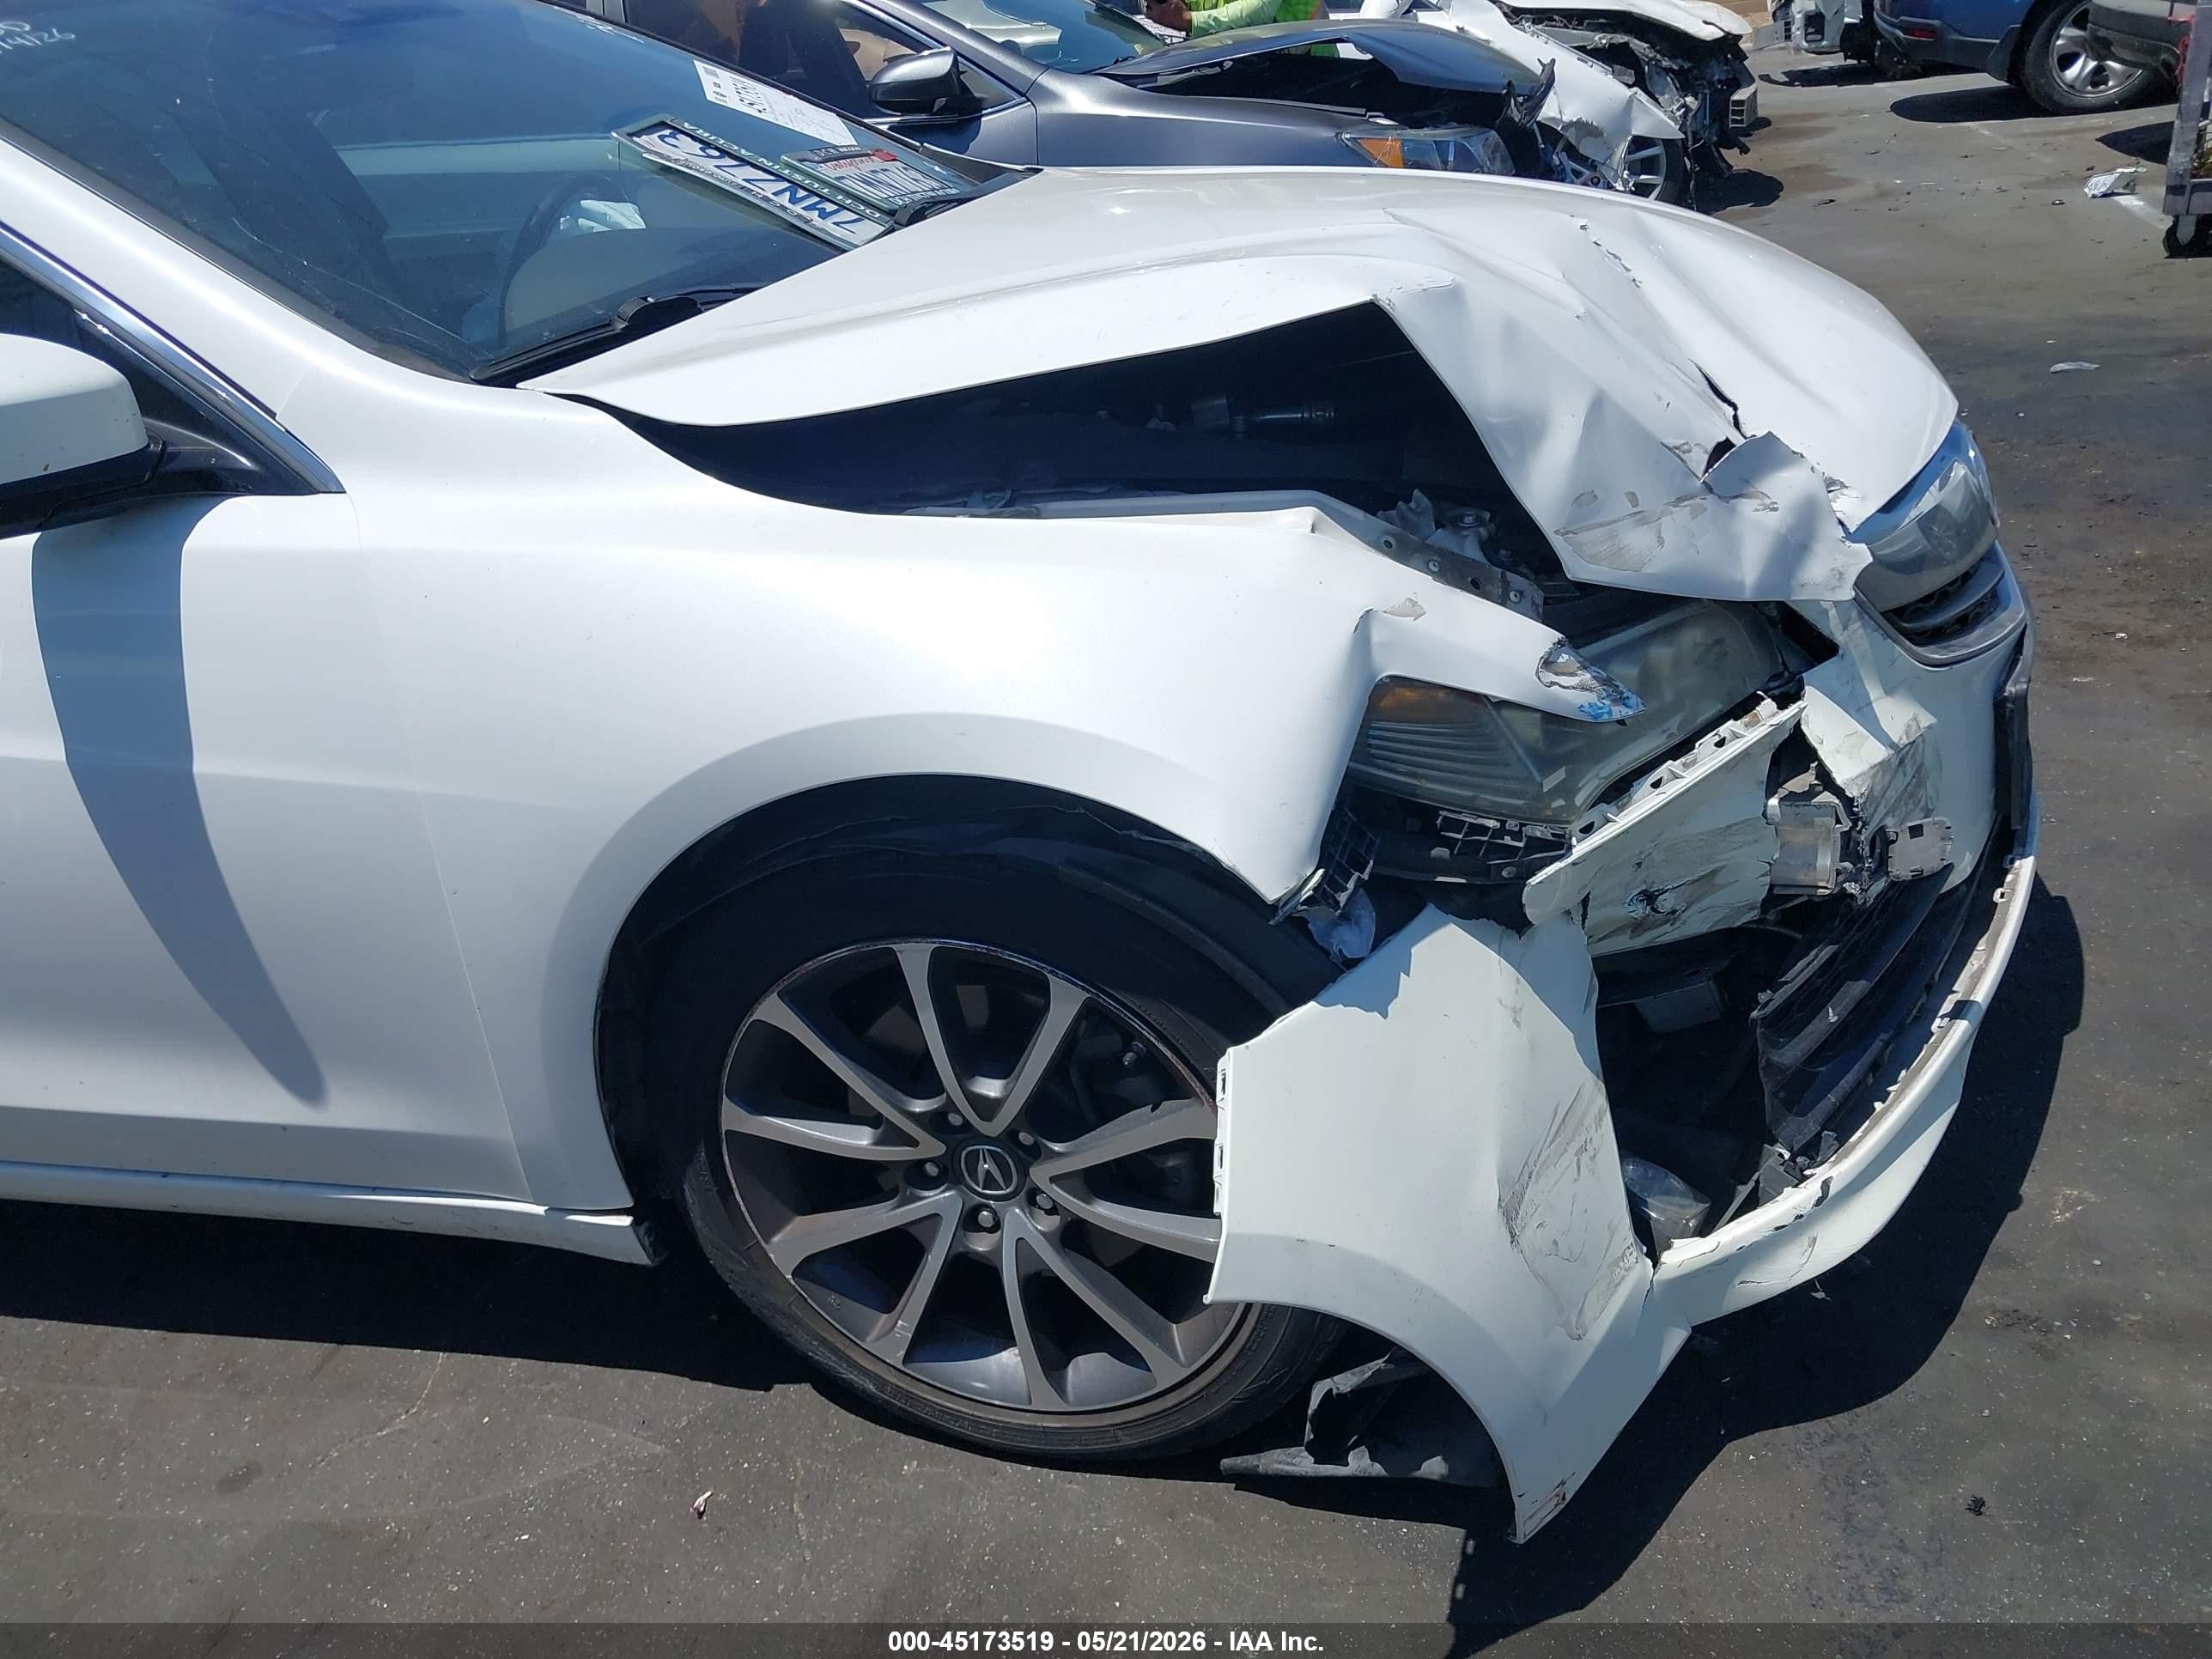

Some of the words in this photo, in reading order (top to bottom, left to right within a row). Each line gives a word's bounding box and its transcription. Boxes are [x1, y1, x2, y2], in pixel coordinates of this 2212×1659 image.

[684, 122, 755, 156] ACURA
[757, 157, 831, 195] TUSTIN
[836, 195, 881, 218] DCH
